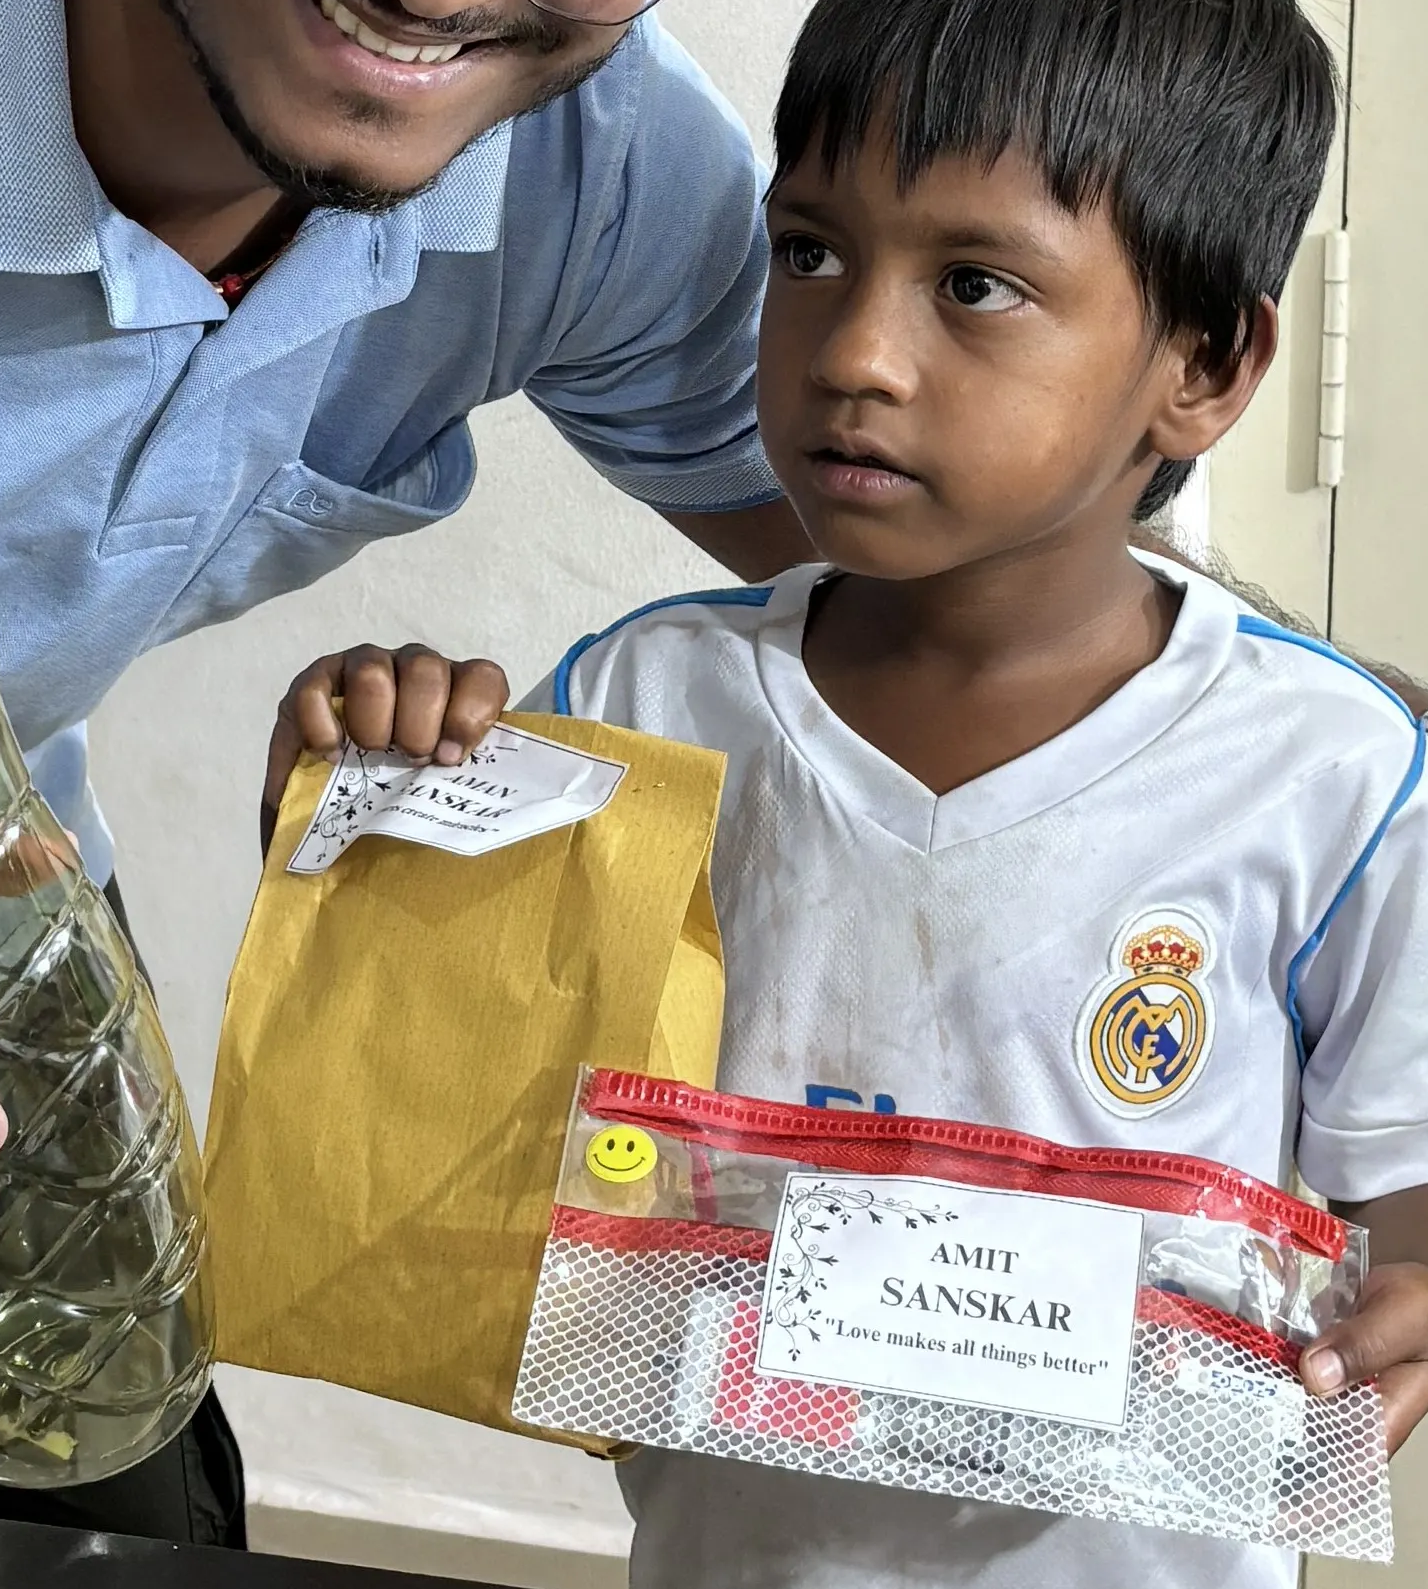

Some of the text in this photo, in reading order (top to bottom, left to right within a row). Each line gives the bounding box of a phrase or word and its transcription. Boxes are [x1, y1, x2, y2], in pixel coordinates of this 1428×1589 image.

[442, 775, 518, 799] AMAN
[930, 1242, 1019, 1274] AMIT
[880, 1277, 1072, 1332] SANSKAR
[825, 1317, 1109, 1376] "Love makes all things better"
